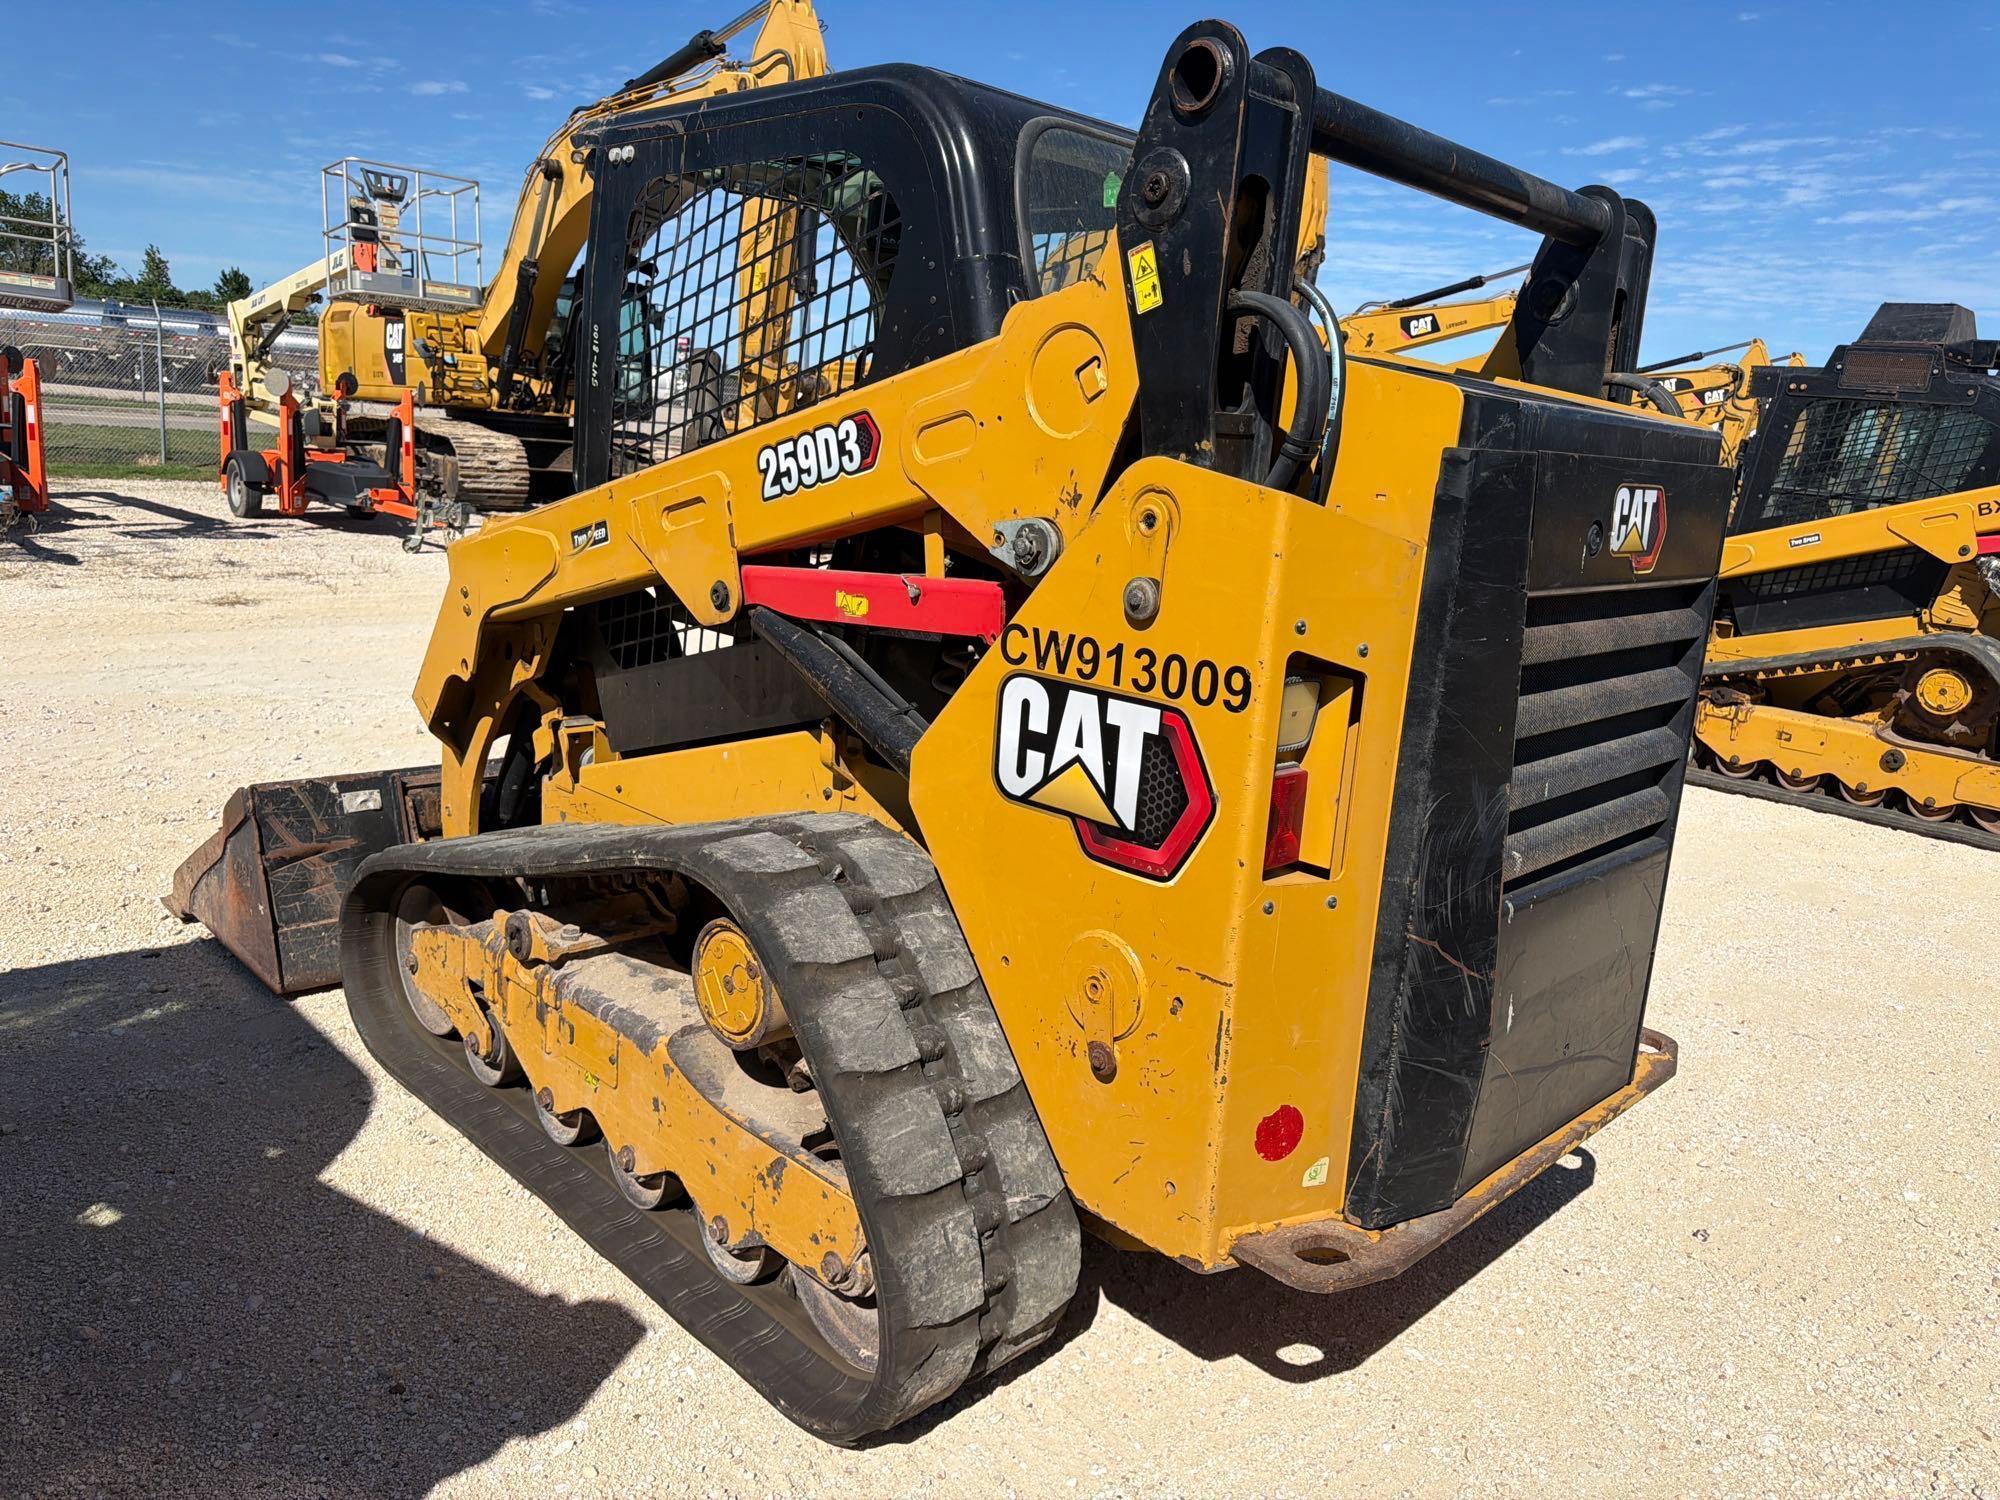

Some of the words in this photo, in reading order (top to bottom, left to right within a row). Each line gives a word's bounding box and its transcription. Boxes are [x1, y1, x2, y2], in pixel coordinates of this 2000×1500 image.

[386, 322, 404, 350] CAT
[1410, 316, 1433, 337] CAT
[1704, 389, 1725, 405] CAT
[759, 419, 861, 499] 259D3
[1611, 487, 1658, 552] CAT
[1000, 623, 1252, 713] CW913009
[998, 676, 1162, 832] CAT
